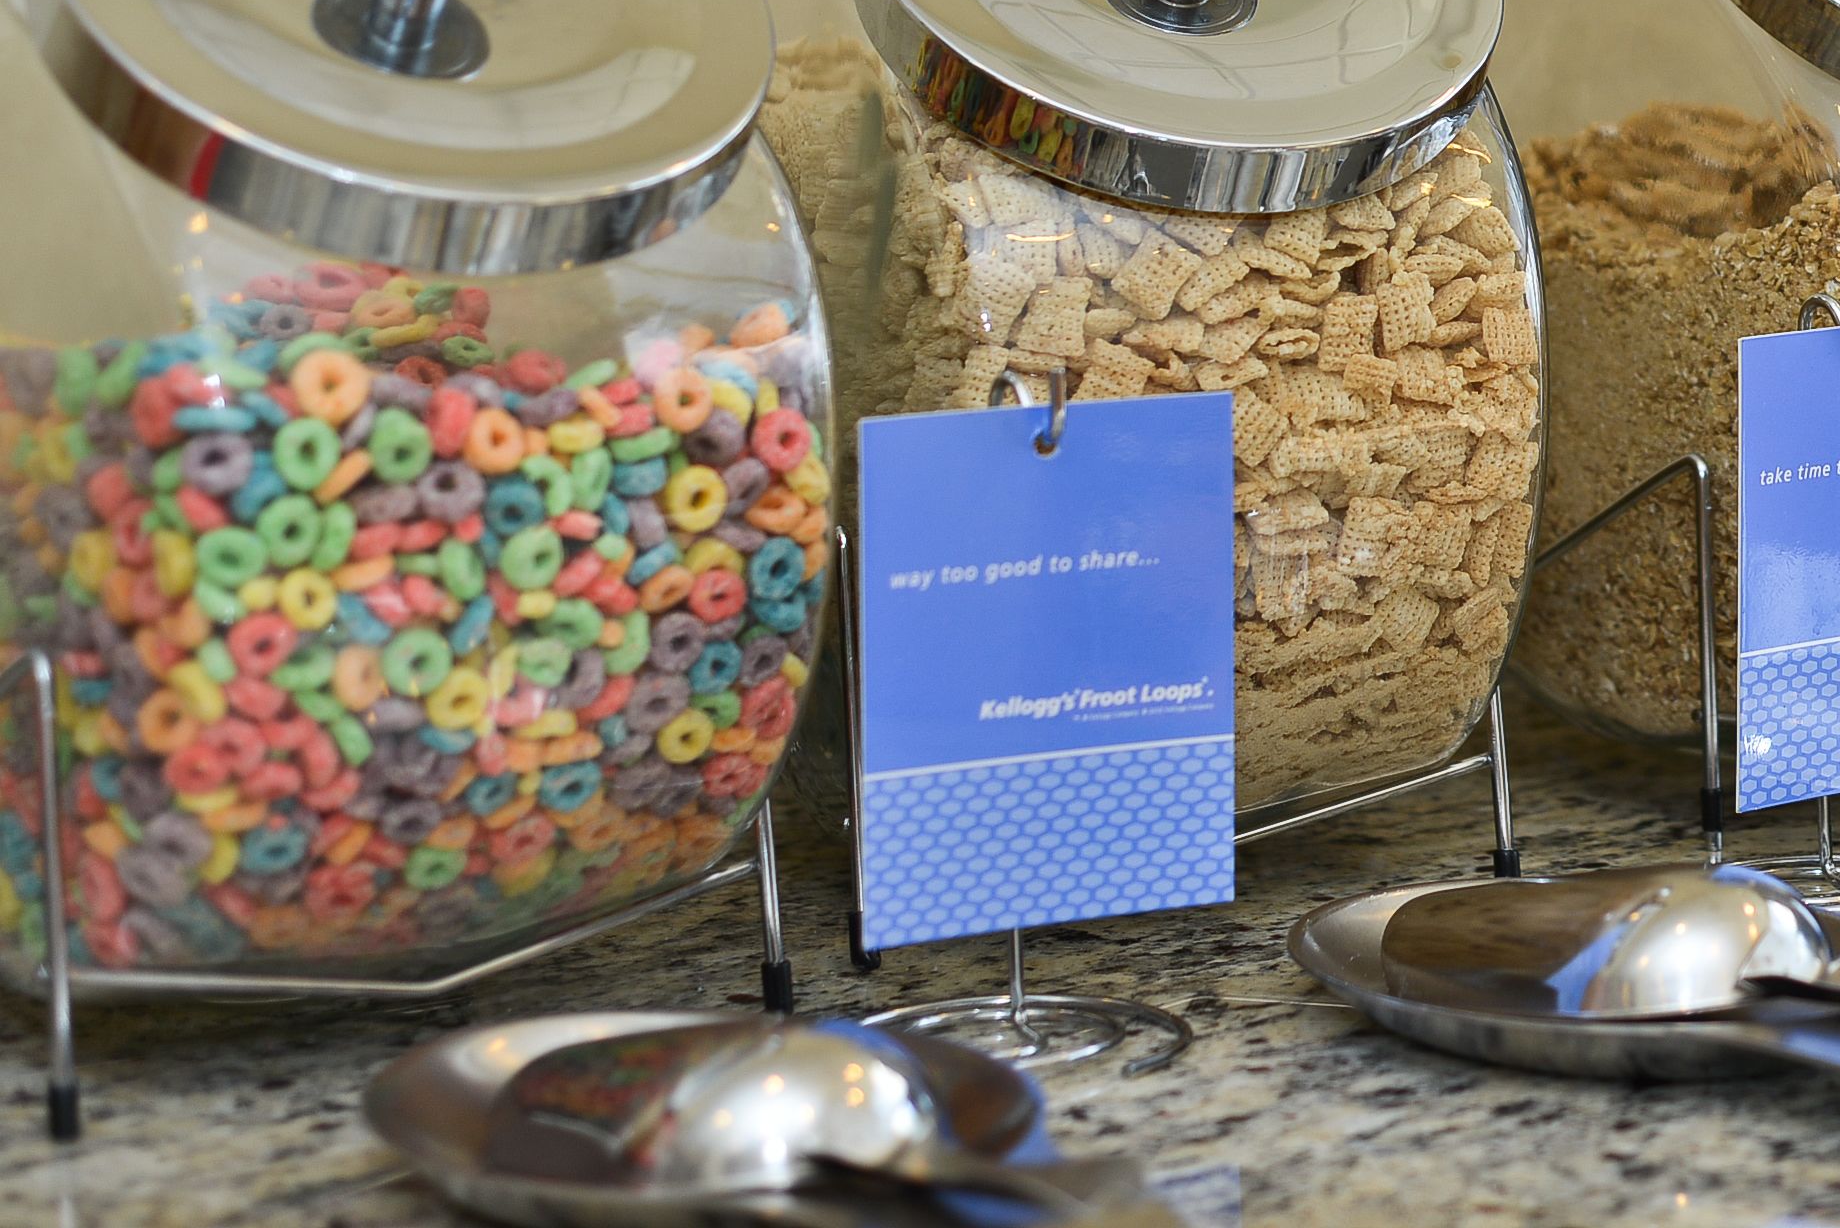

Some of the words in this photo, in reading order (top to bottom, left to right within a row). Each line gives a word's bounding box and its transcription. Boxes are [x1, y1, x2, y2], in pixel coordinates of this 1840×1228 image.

[1760, 467, 1792, 485] take
[1798, 463, 1830, 480] time
[890, 569, 934, 591] way
[941, 566, 978, 584] too
[985, 554, 1043, 584] good
[1050, 555, 1073, 573] to
[1079, 549, 1160, 570] share...
[1079, 686, 1138, 709] Froot
